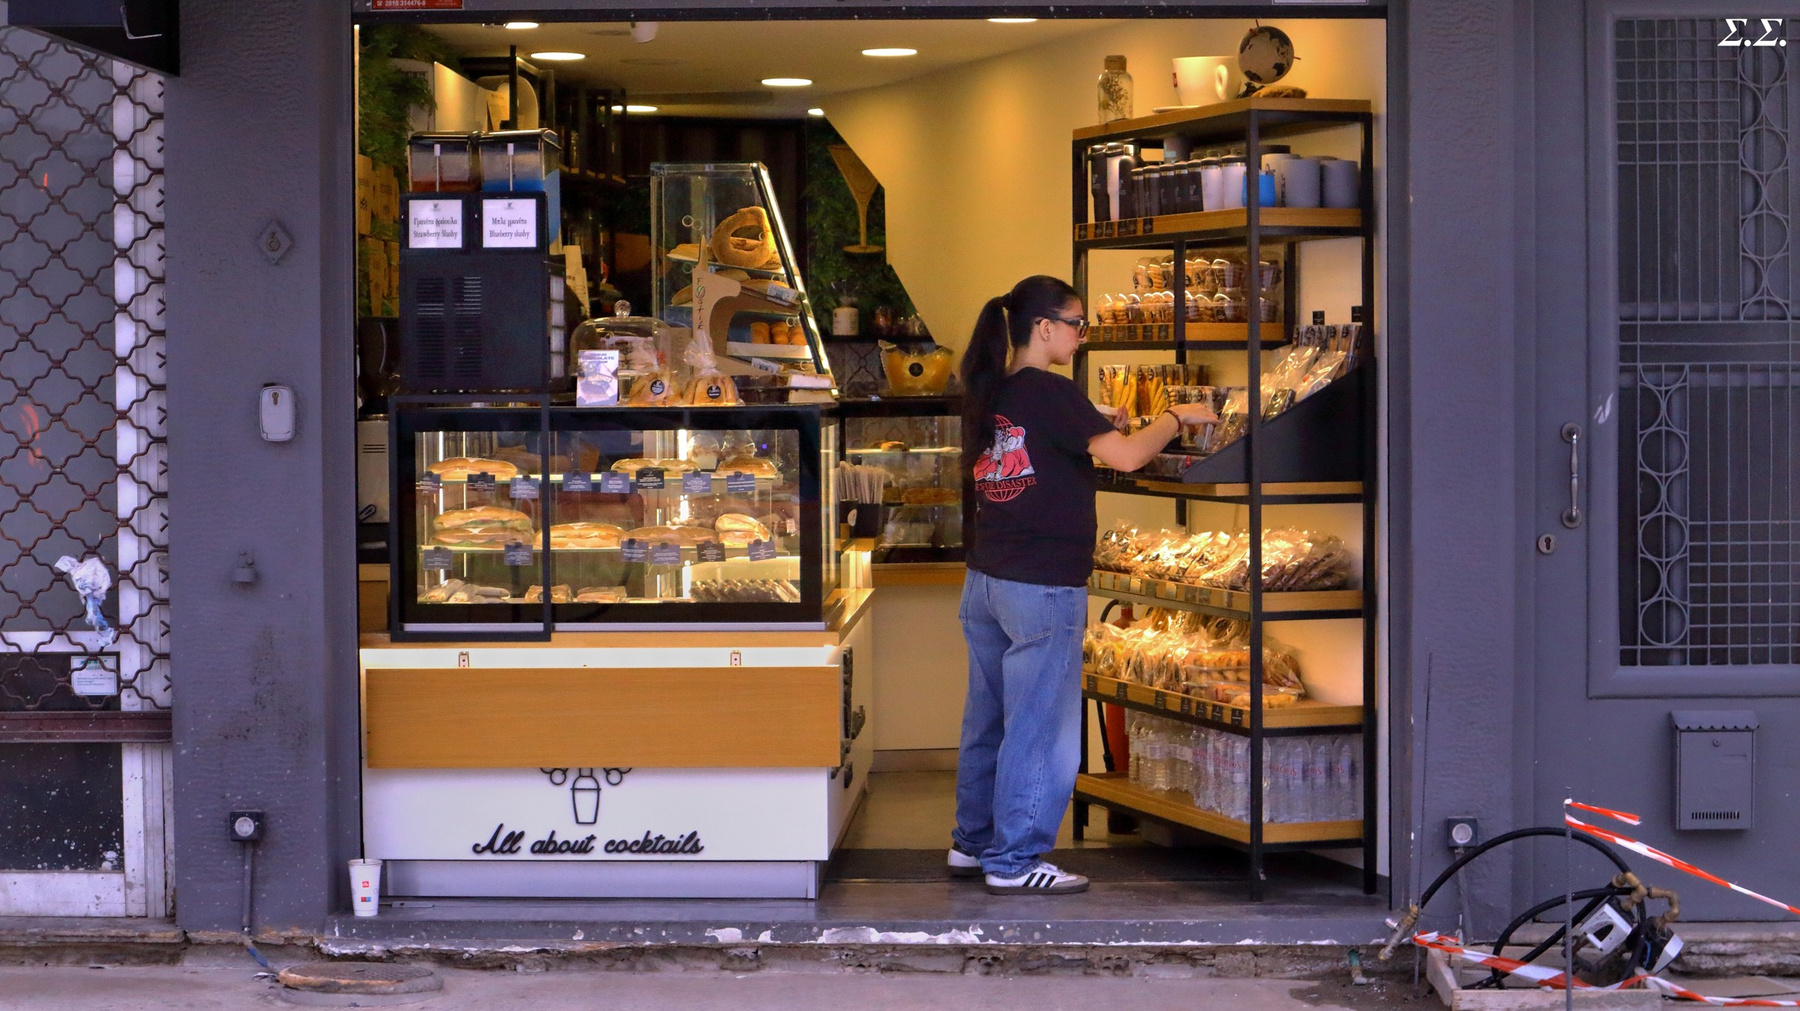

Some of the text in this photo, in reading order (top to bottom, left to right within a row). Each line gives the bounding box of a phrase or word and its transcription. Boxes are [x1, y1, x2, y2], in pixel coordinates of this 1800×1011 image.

[413, 229, 458, 240] Strawberry Slushy
[489, 229, 513, 240] Blueberry
[997, 476, 1036, 489] DISASTER
[472, 823, 705, 855] All about cocktails
